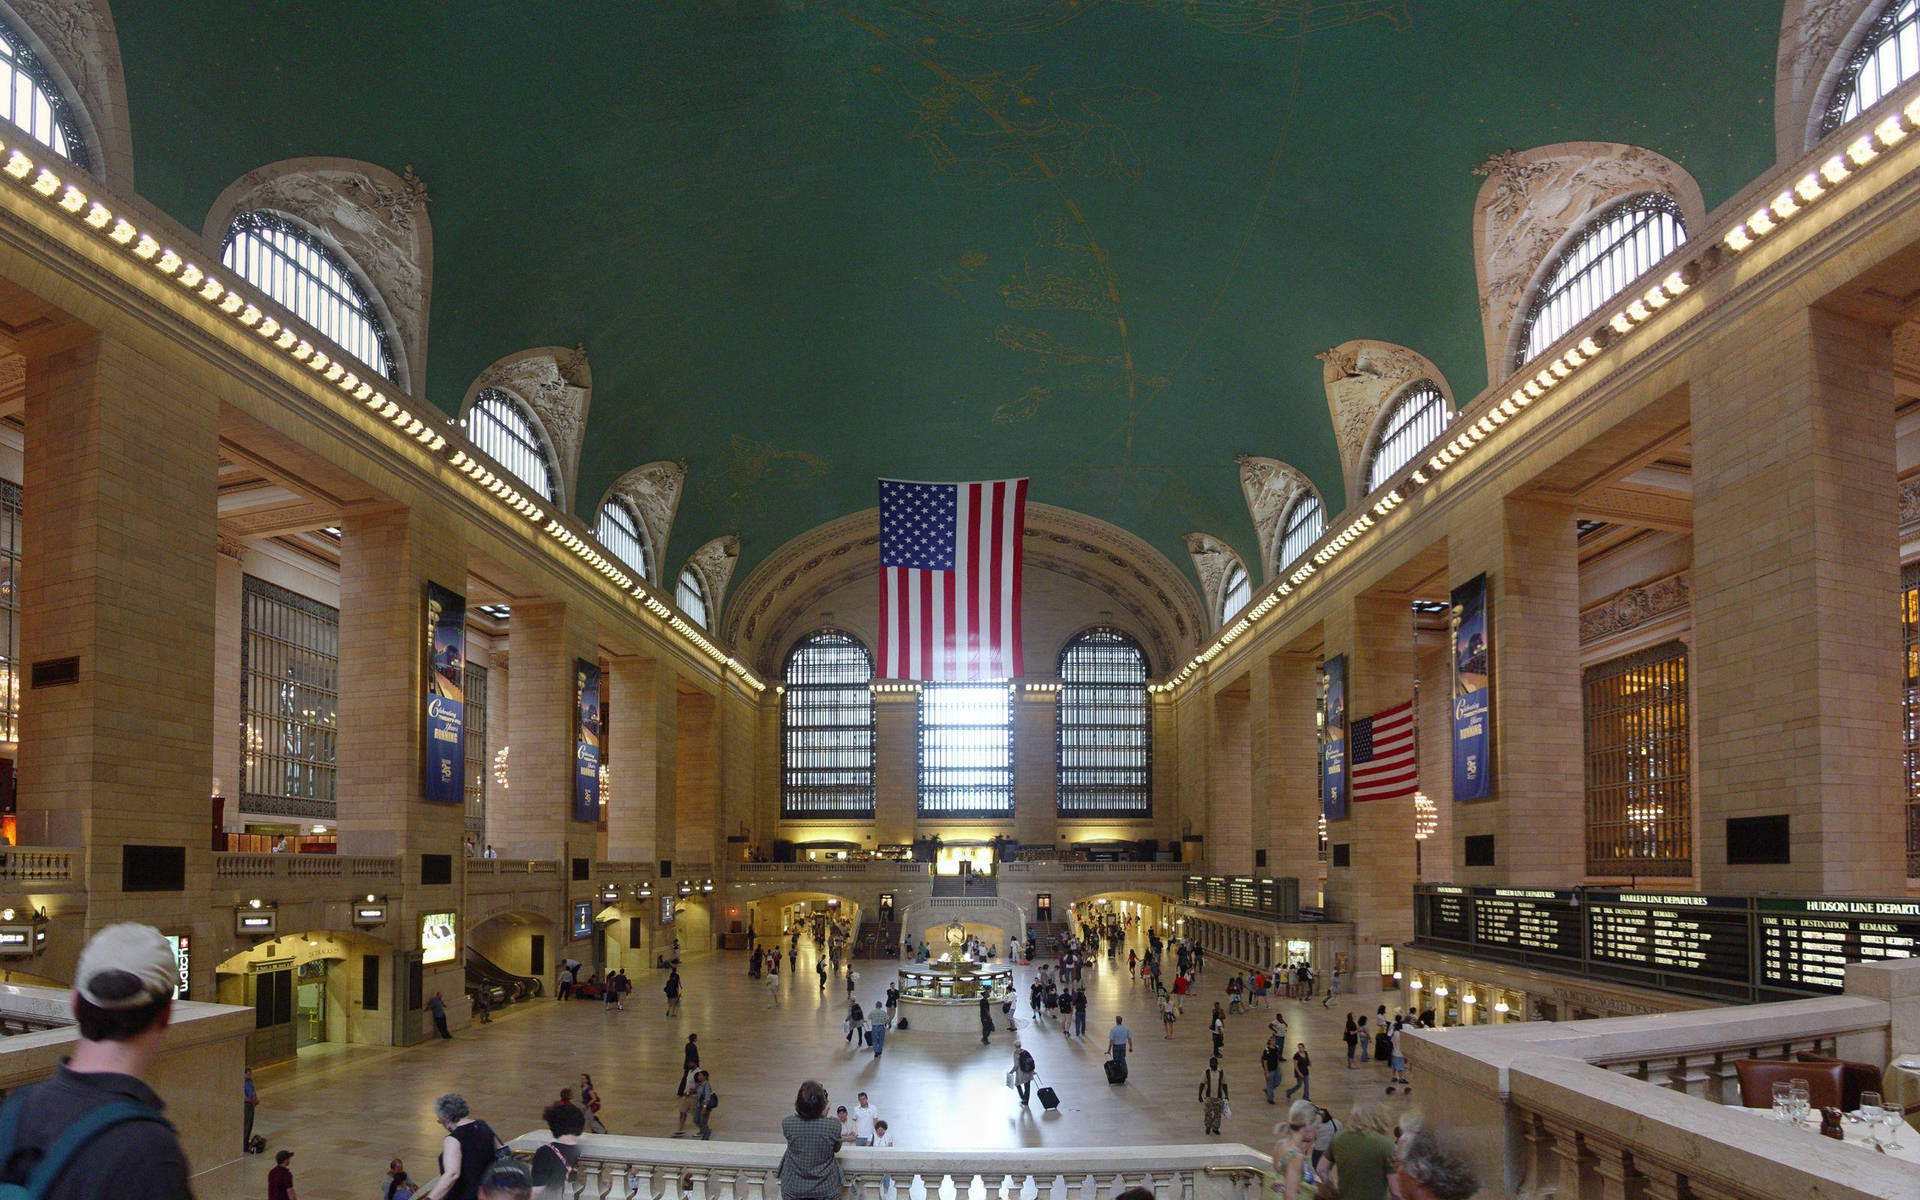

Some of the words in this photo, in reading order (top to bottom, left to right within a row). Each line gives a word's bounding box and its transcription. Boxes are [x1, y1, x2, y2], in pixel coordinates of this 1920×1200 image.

[1620, 894, 1647, 903] HARLEM
[1647, 895, 1663, 904] LINE
[1664, 896, 1708, 906] DEPARTURES
[1807, 901, 1848, 912] HUDSON
[1850, 902, 1874, 912] LINE
[1763, 917, 1778, 925] TIME
[1782, 918, 1797, 927] TRK
[1801, 919, 1848, 929] DESTINATION
[1859, 922, 1898, 932] REMARKS
